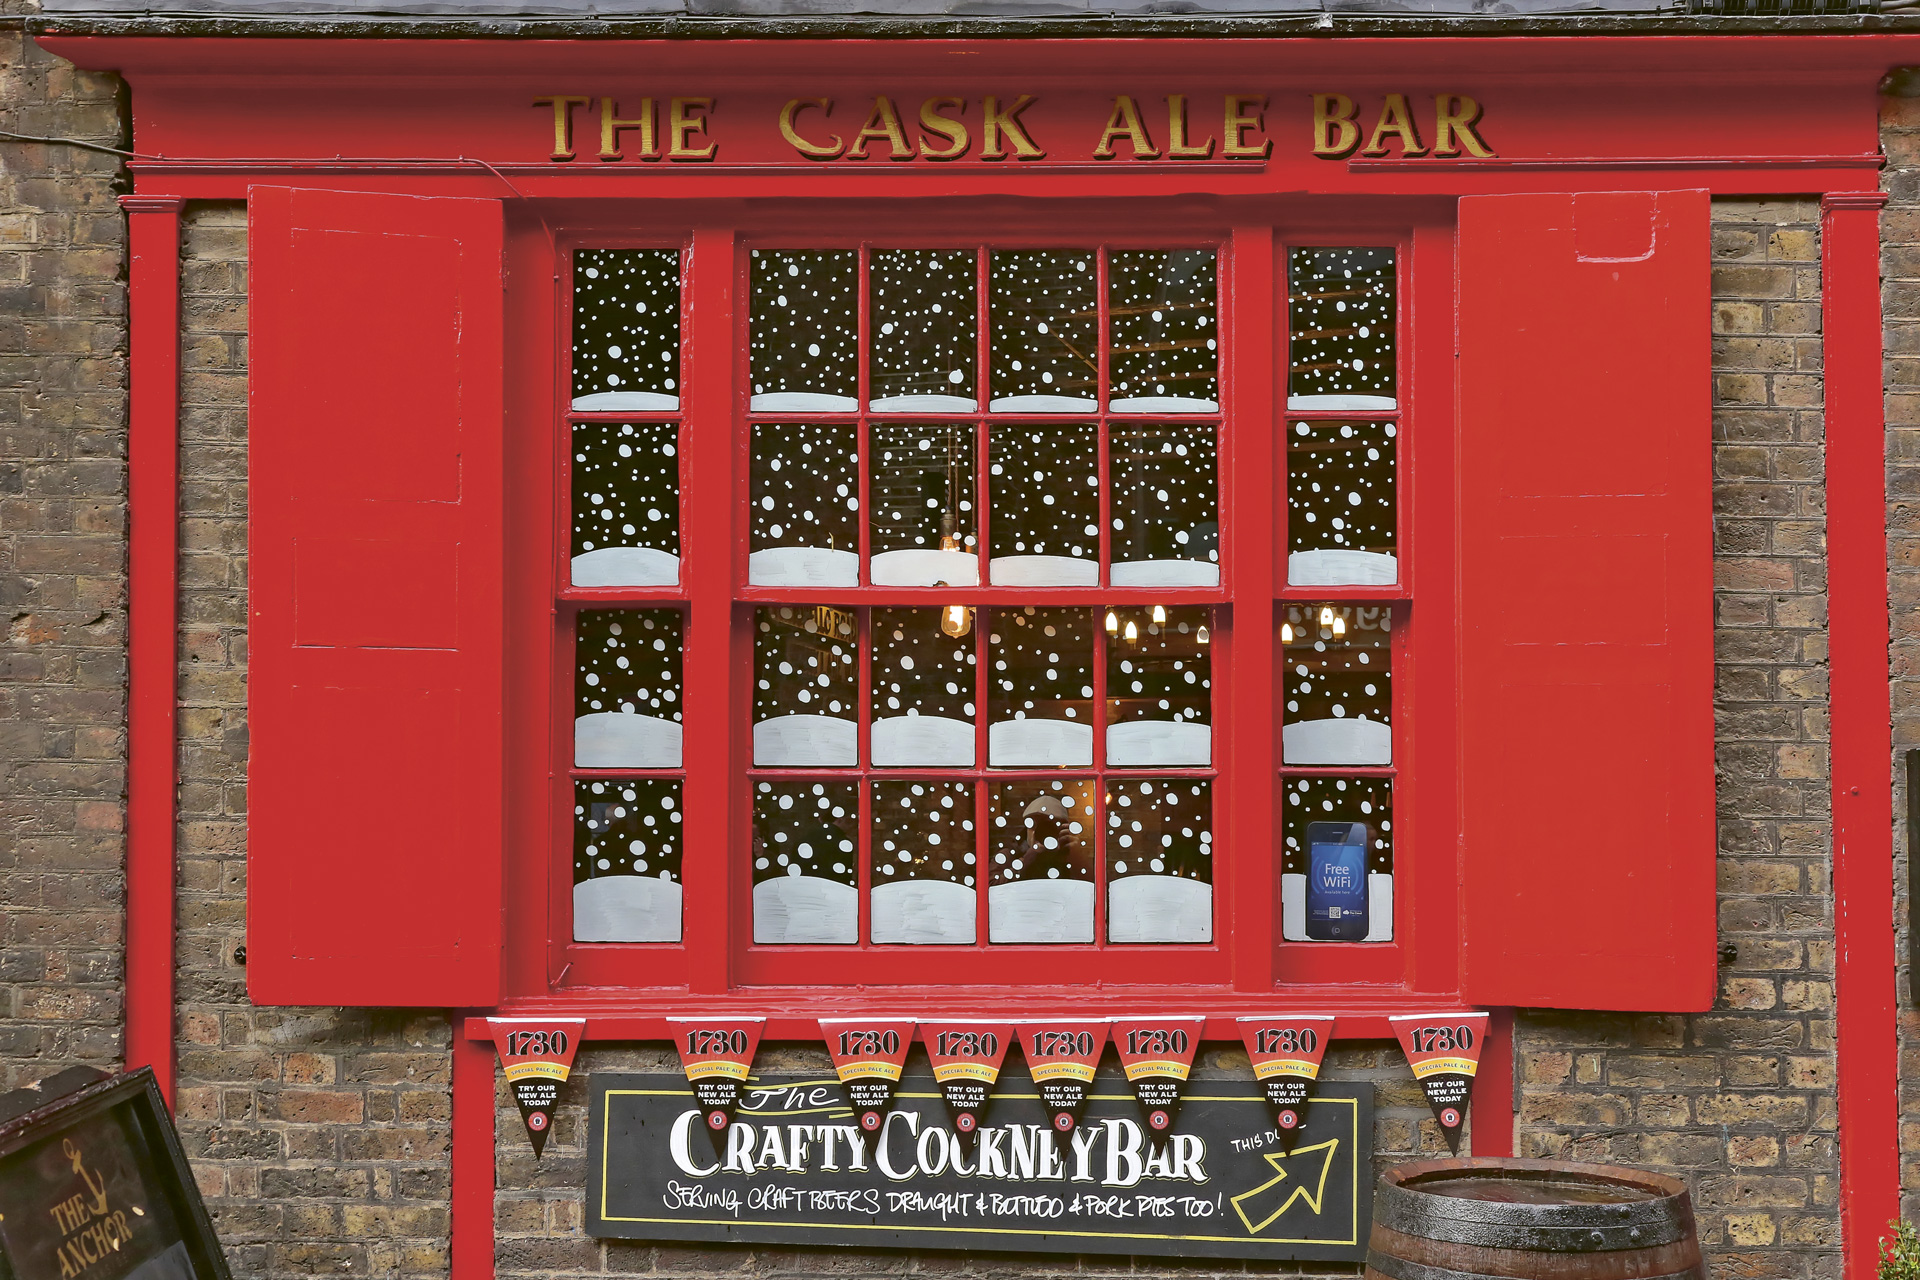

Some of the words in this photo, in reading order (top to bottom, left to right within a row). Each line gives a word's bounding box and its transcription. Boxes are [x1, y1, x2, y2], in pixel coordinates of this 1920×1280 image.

[532, 95, 719, 162] THE
[779, 95, 1046, 161] CASK
[1093, 94, 1273, 160] ALE
[1309, 92, 1499, 160] BAR
[1325, 863, 1350, 874] Free
[1323, 876, 1351, 888] WiFi
[506, 1030, 568, 1056] 1730
[686, 1029, 748, 1055] 1730
[838, 1030, 900, 1056] 1730
[936, 1030, 998, 1057] 1730
[1032, 1030, 1094, 1056] 1730
[1126, 1029, 1188, 1055] 1730
[1255, 1028, 1317, 1054] 1730
[1411, 1025, 1473, 1054] 1730
[510, 1067, 534, 1075] SPECIAL
[691, 1066, 714, 1074] SPECIAL
[843, 1067, 866, 1075] SPECIAL
[1037, 1068, 1060, 1076] SPECIAL
[1131, 1066, 1155, 1074] SPECIAL
[1260, 1065, 1284, 1073] SPECIAL
[1418, 1064, 1441, 1072] SPECIAL
[738, 1087, 840, 1110] The
[669, 1109, 869, 1178] CRAFTY
[1100, 1118, 1211, 1188] BAR
[1230, 1133, 1263, 1153] THIS
[662, 1180, 742, 1218] SERVING
[748, 1184, 807, 1212] CRAFT
[809, 1188, 881, 1215] BEERS
[885, 1191, 974, 1222] DRAUGHT
[976, 1192, 989, 1216] &
[989, 1193, 1064, 1218] BOTTLED
[1068, 1192, 1083, 1216] &
[1083, 1195, 1134, 1218] PORK
[1135, 1196, 1176, 1218] PIES
[50, 1193, 90, 1236] THE
[56, 1210, 133, 1280] ANCHOR
